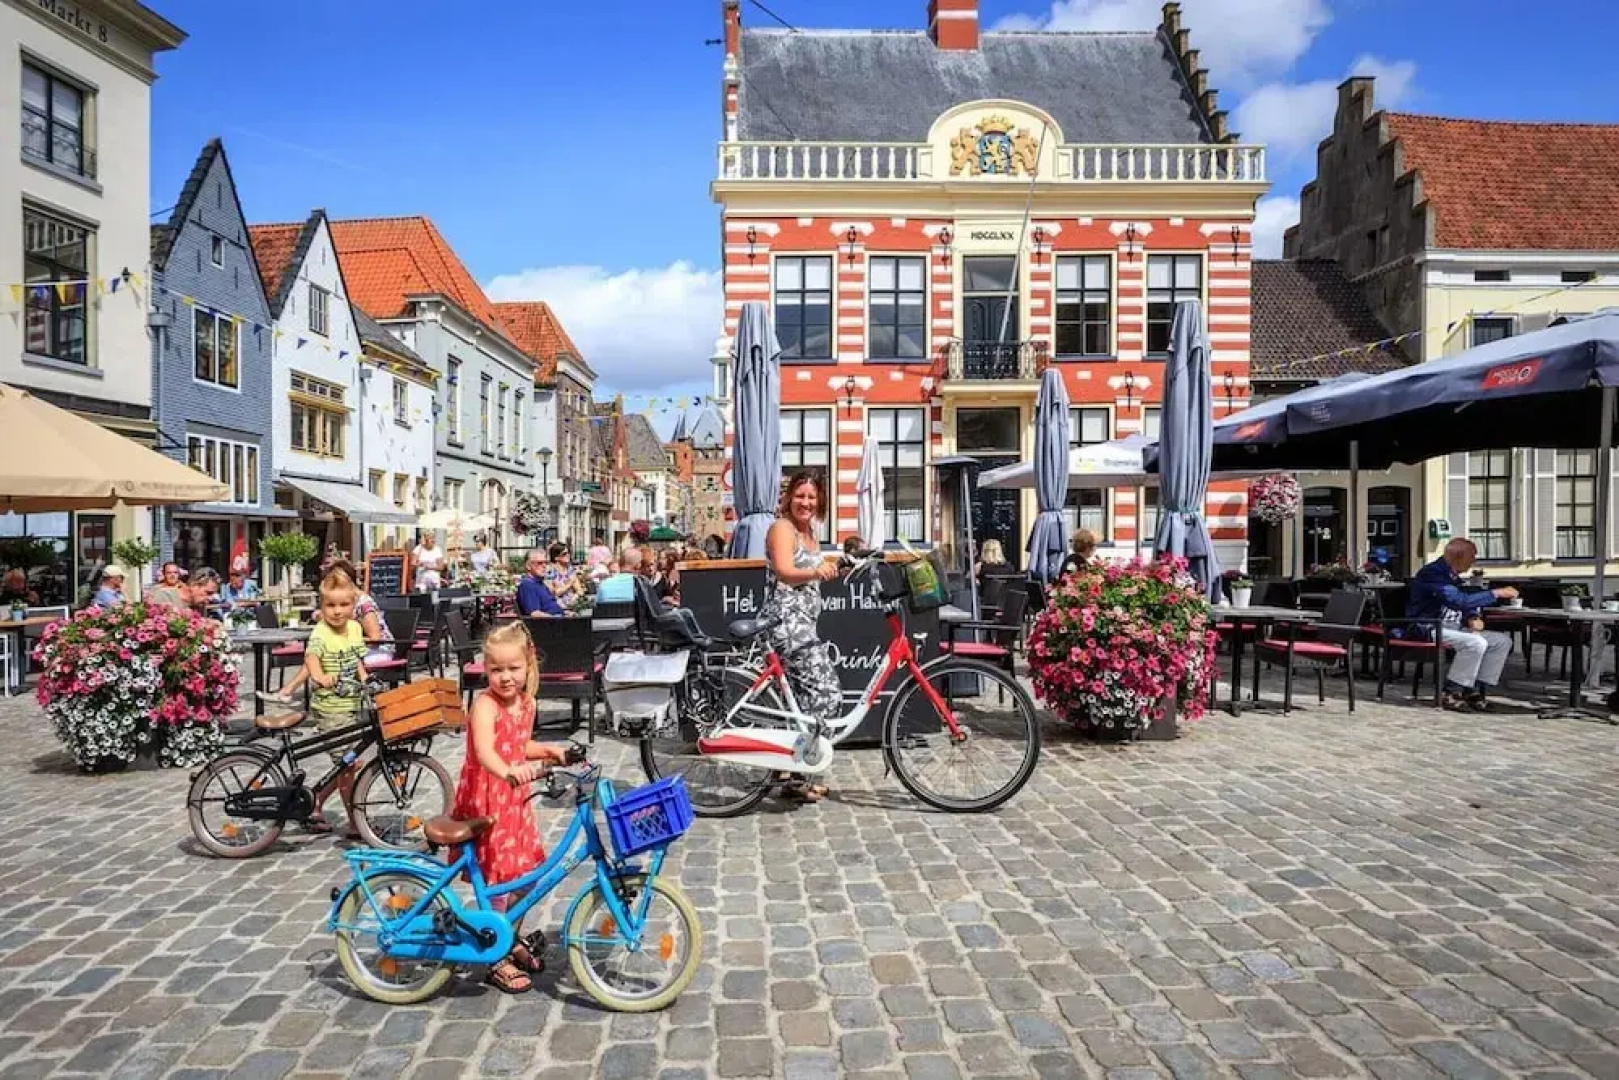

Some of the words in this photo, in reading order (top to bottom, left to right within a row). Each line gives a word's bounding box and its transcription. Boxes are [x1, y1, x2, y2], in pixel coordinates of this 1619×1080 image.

[40, 0, 92, 35] Markt
[98, 24, 108, 43] 8
[721, 585, 758, 615] Het
[820, 596, 846, 611] van
